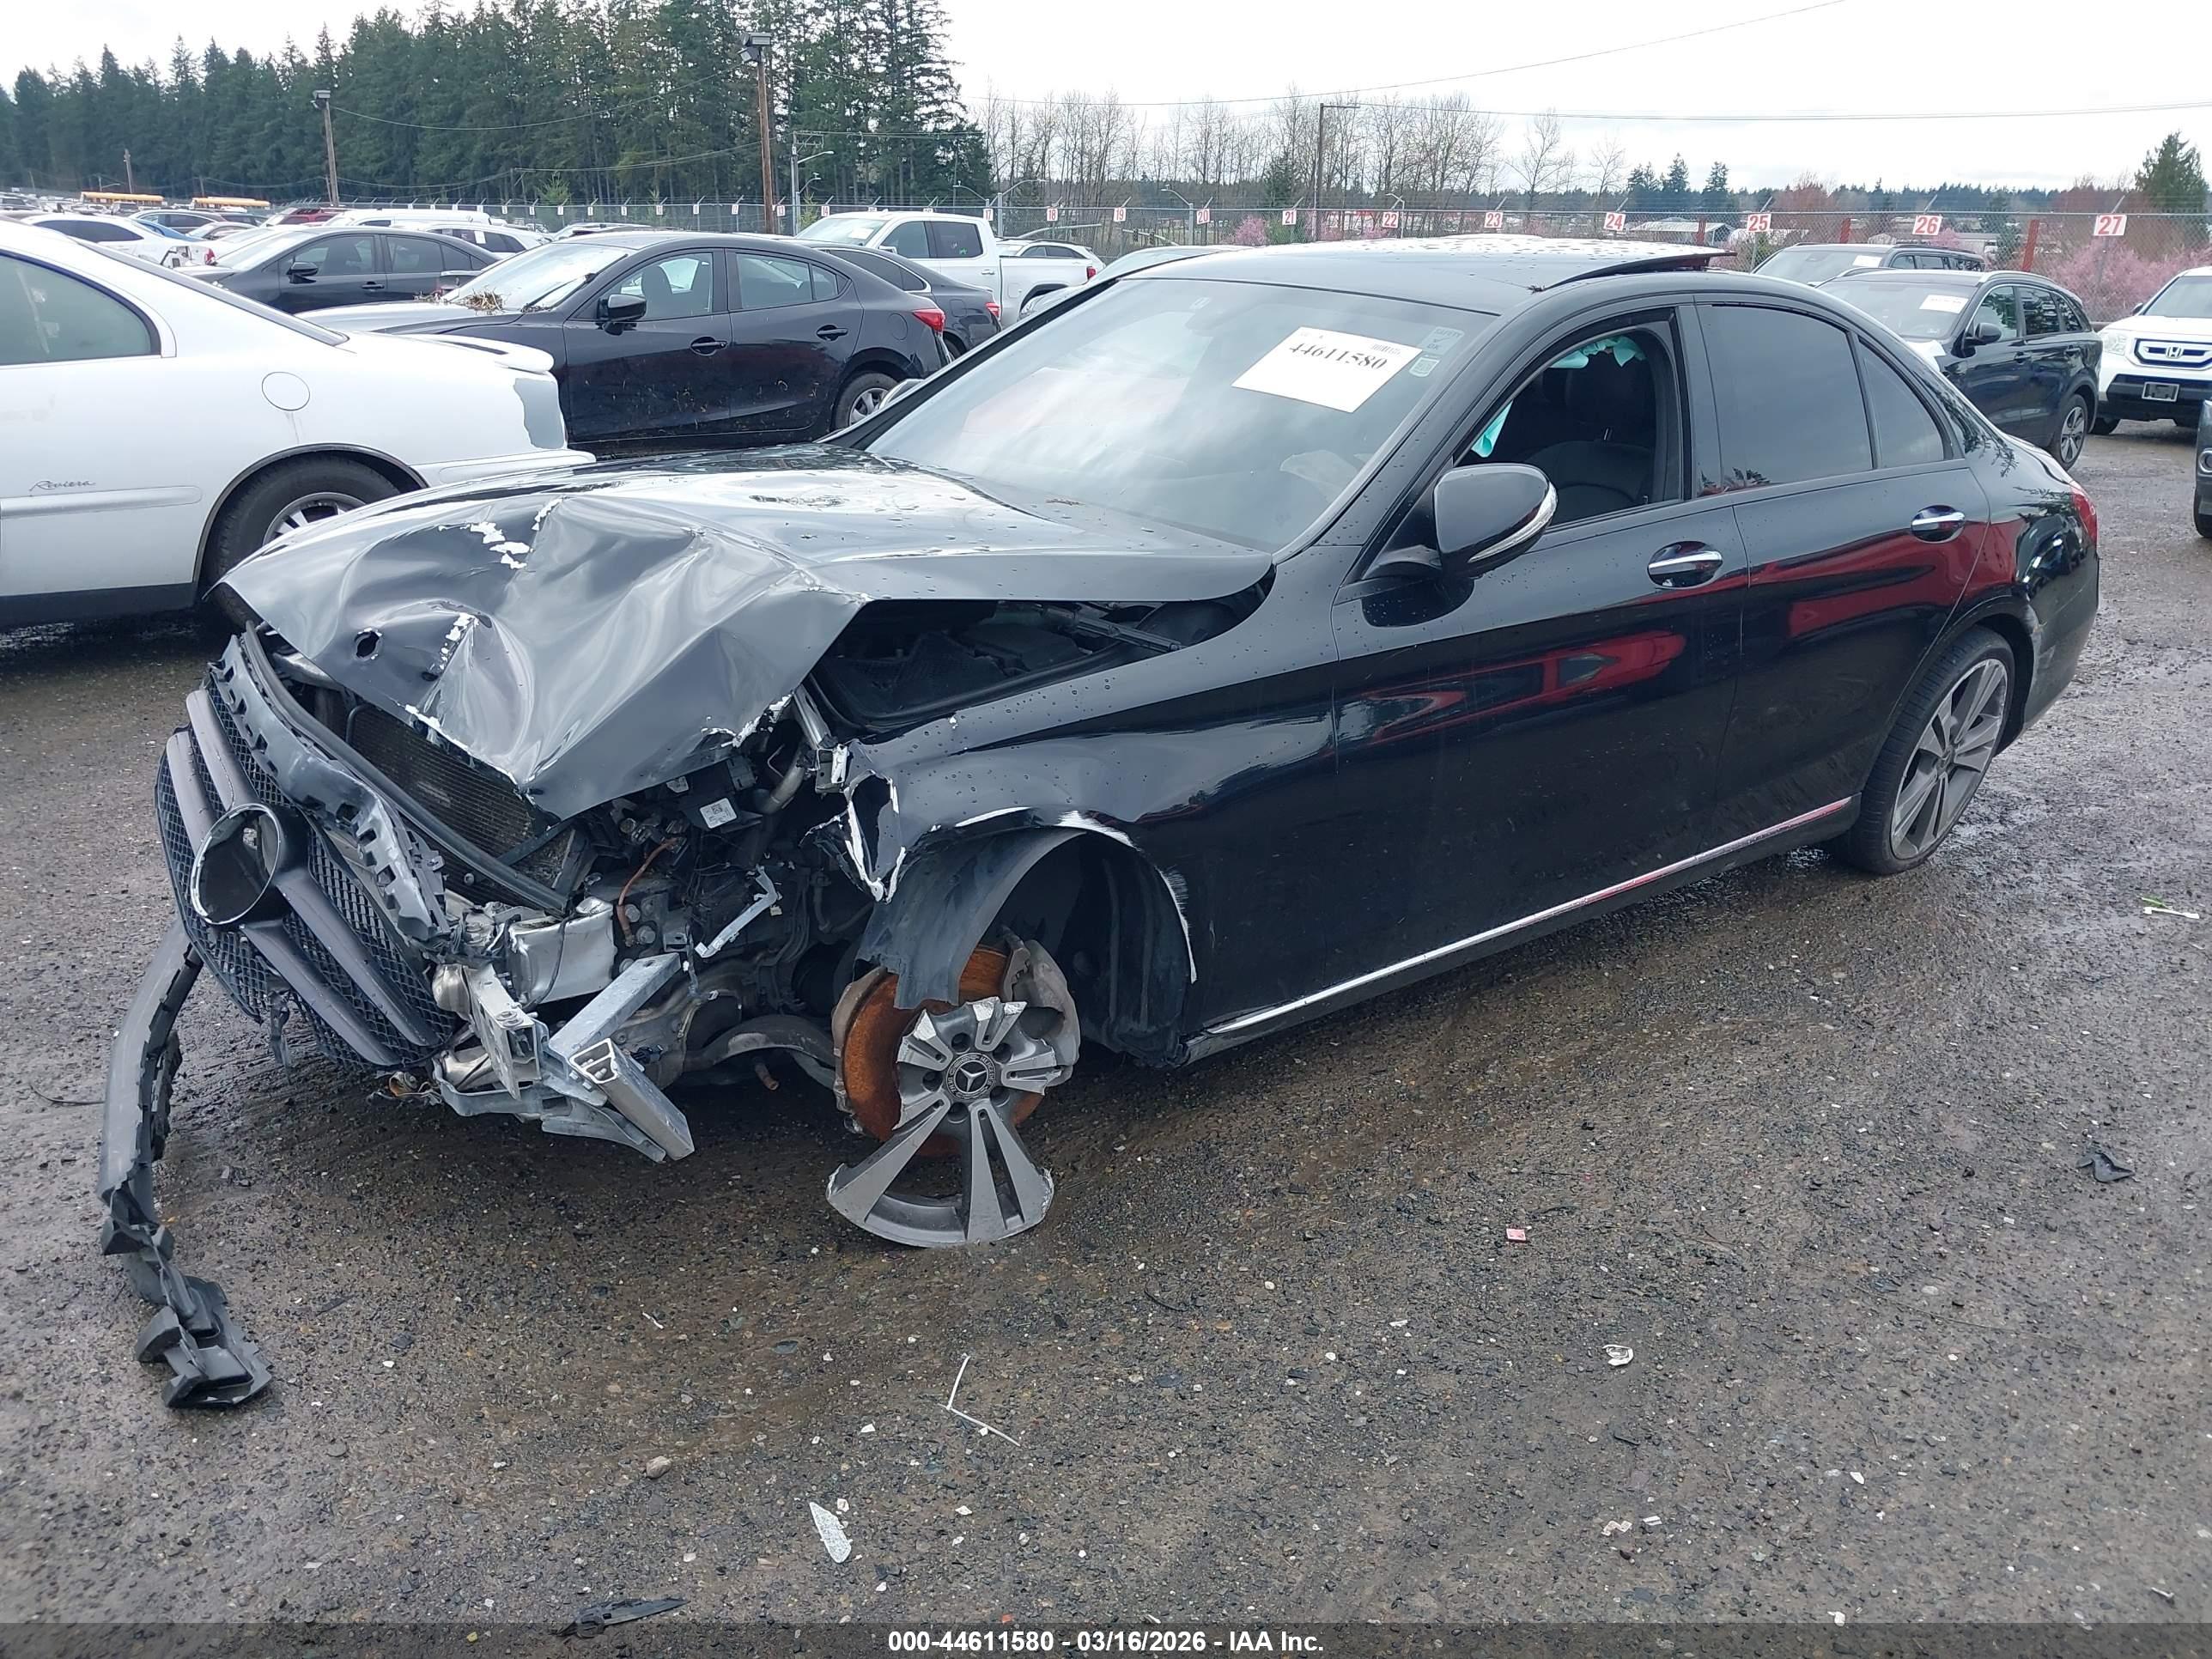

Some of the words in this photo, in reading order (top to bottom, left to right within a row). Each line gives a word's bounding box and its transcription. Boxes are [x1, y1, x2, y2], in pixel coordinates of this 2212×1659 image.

[1198, 210, 1209, 223] 20
[1285, 210, 1295, 224] 21
[1384, 213, 1397, 227] 22
[1486, 213, 1500, 227] 23
[1606, 213, 1623, 229] 24
[1748, 215, 1768, 232] 25
[1915, 216, 1939, 234] 26
[2098, 216, 2124, 235] 27
[1289, 343, 1388, 370] 44611580
[28, 480, 96, 492] Riviera
